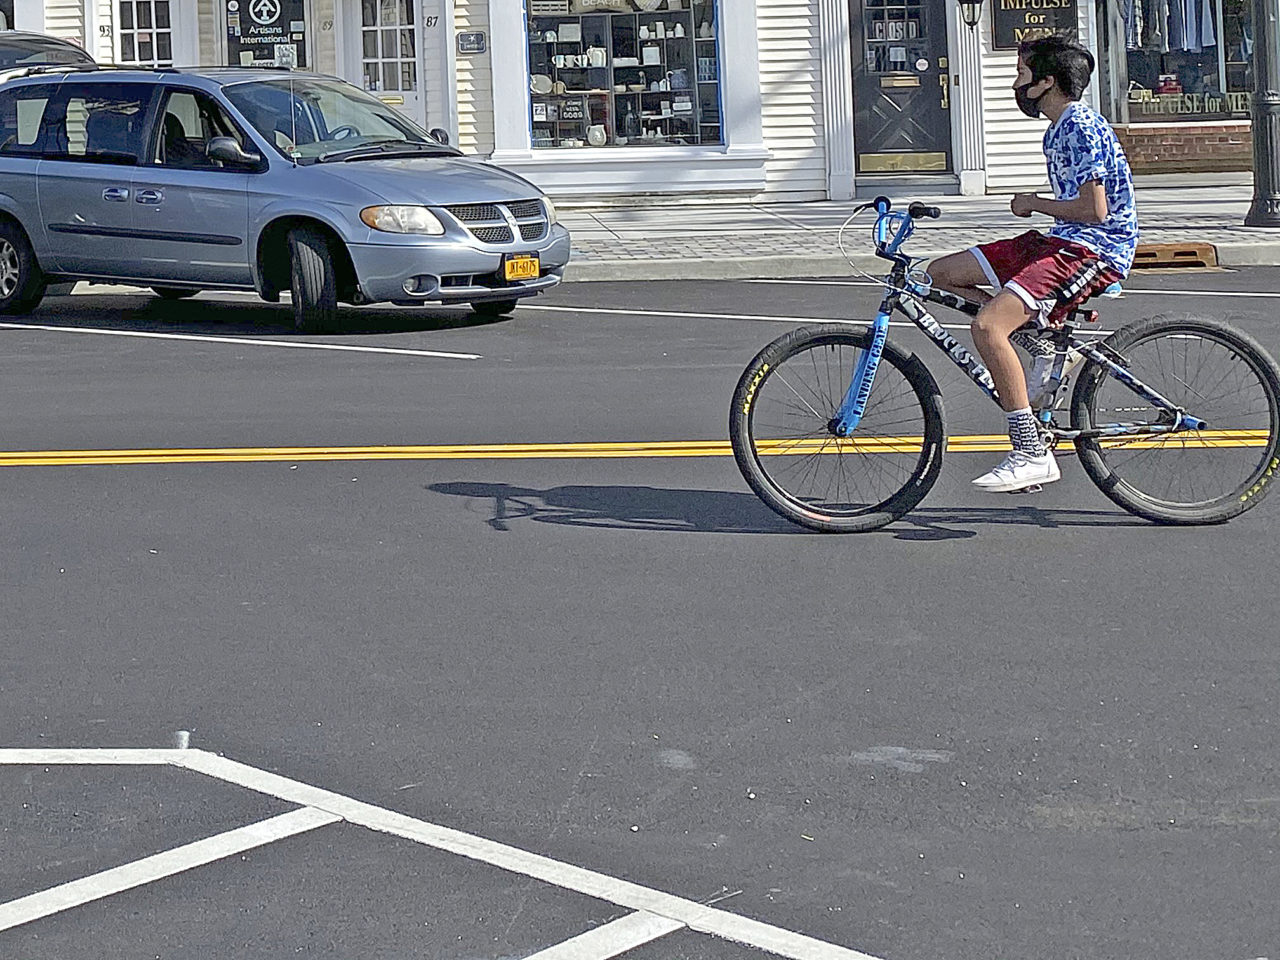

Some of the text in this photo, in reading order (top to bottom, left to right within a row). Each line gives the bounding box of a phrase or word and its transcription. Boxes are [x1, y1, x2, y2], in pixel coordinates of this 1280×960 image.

[426, 16, 438, 28] 87
[1025, 12, 1046, 23] for
[100, 25, 110, 37] 93
[249, 26, 282, 34] Artisans
[322, 21, 333, 31] 89
[240, 33, 291, 44] International
[1205, 93, 1221, 113] for
[919, 312, 973, 372] BLOCKS
[743, 363, 769, 415] MAXXIS
[851, 360, 878, 417] LANDING
